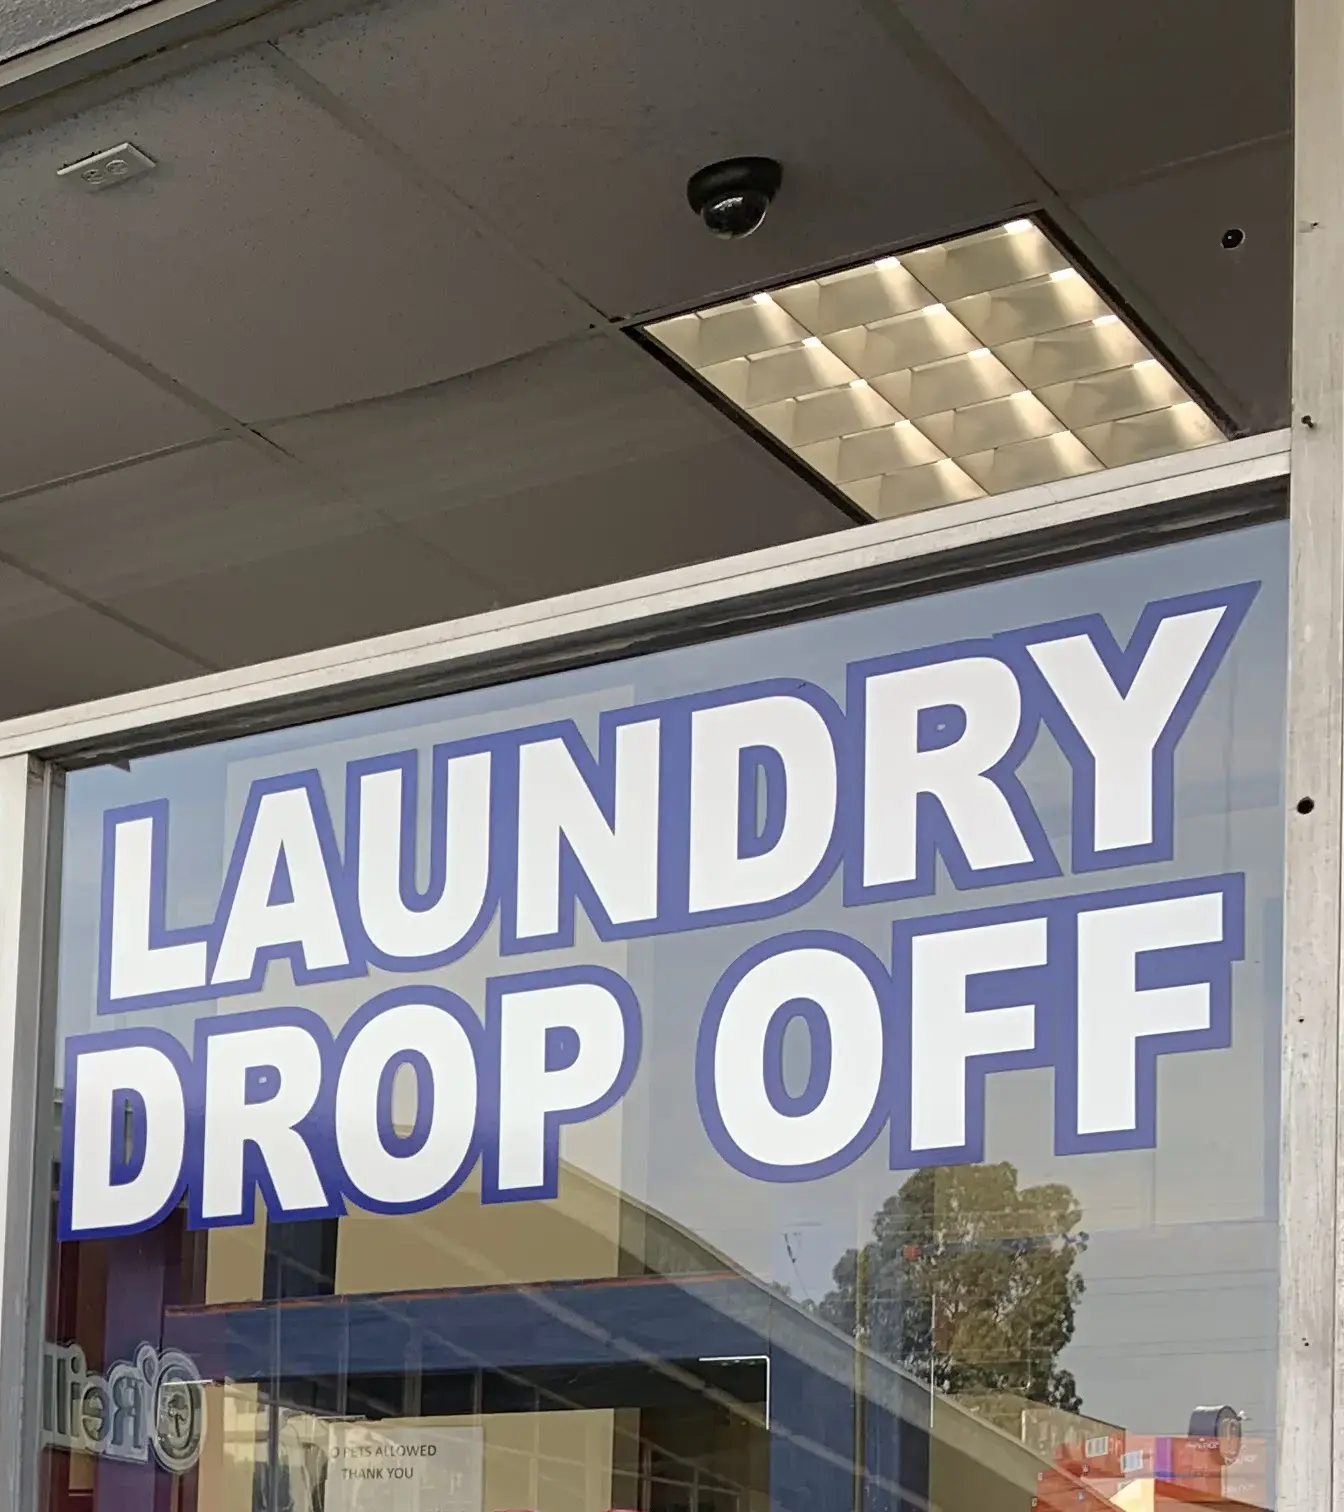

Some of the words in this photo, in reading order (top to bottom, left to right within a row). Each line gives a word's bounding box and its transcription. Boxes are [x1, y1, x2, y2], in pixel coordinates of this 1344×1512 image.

[100, 585, 1252, 1012] LAUNDRY
[60, 966, 640, 1238] DROP
[699, 875, 1244, 1180] OFF
[342, 1445, 369, 1459] PETS
[374, 1443, 438, 1459] ALLOWED
[342, 1467, 387, 1480] THANK
[389, 1467, 415, 1480] YOU
